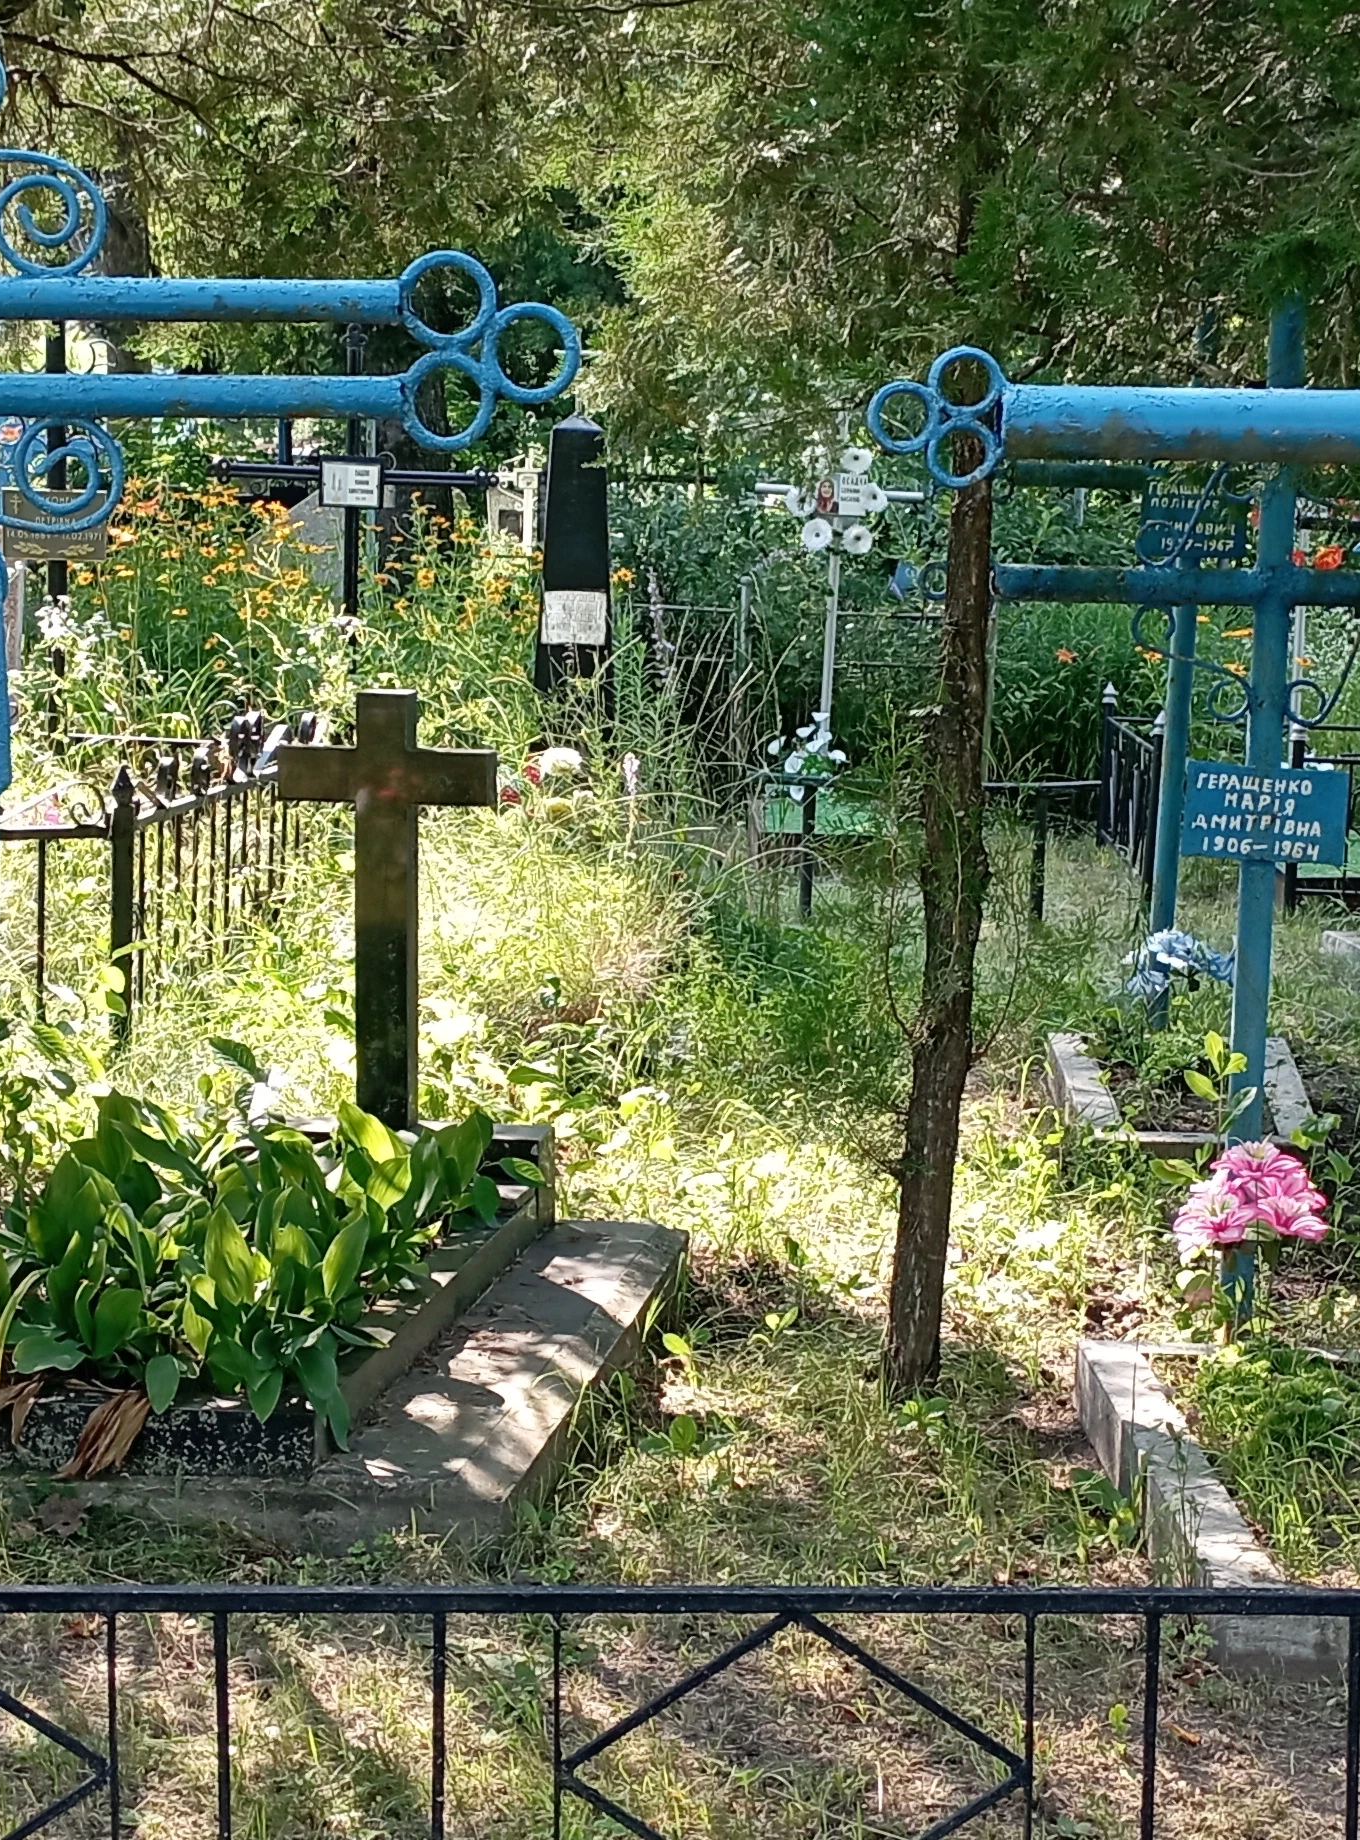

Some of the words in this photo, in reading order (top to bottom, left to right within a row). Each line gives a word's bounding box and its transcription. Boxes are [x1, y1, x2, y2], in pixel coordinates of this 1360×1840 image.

[1196, 772, 1313, 796] ГЕРАЩЕНКО
[1224, 792, 1296, 817] МАРІЯ
[1191, 812, 1322, 838] ДМИТРІВНА
